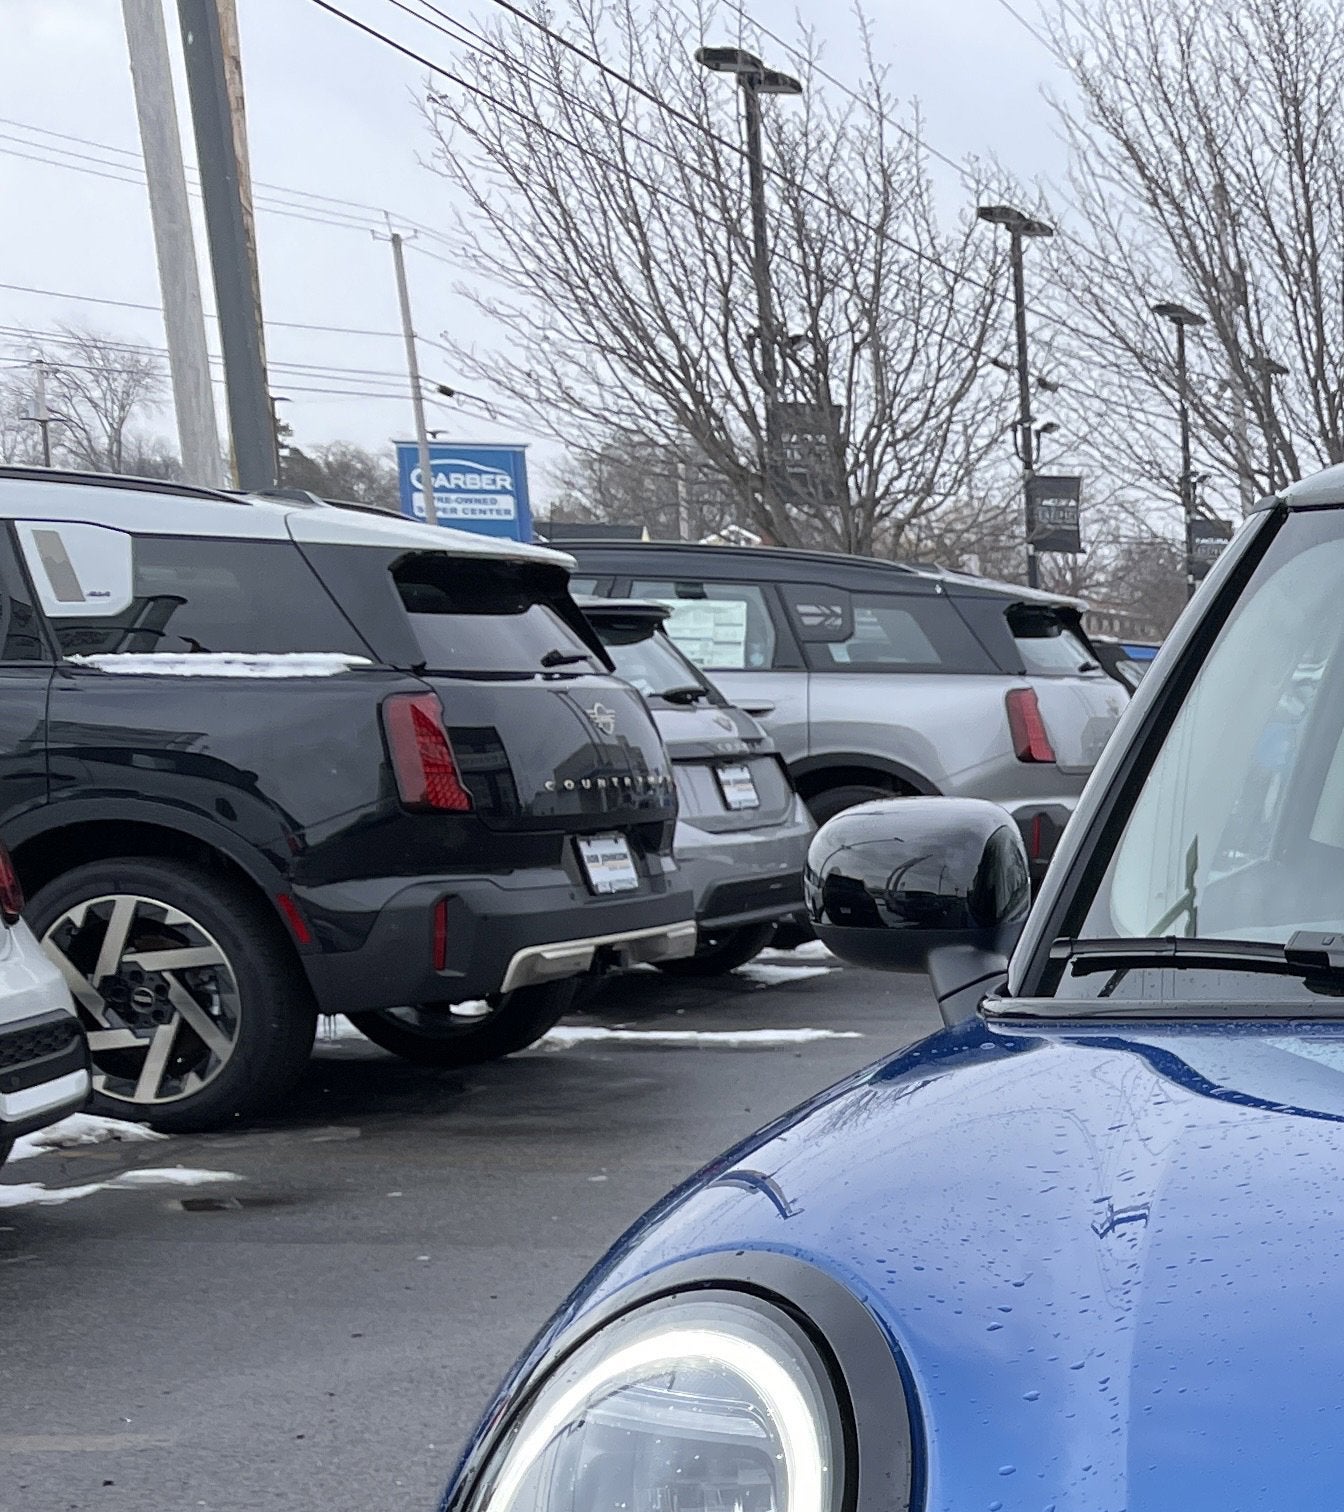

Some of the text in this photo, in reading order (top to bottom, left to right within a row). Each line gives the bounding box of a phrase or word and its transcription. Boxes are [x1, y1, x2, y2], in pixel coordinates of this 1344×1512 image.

[410, 467, 512, 490] GARBER
[433, 496, 498, 505] RE-OWNED
[416, 506, 513, 517] SPER CENTER
